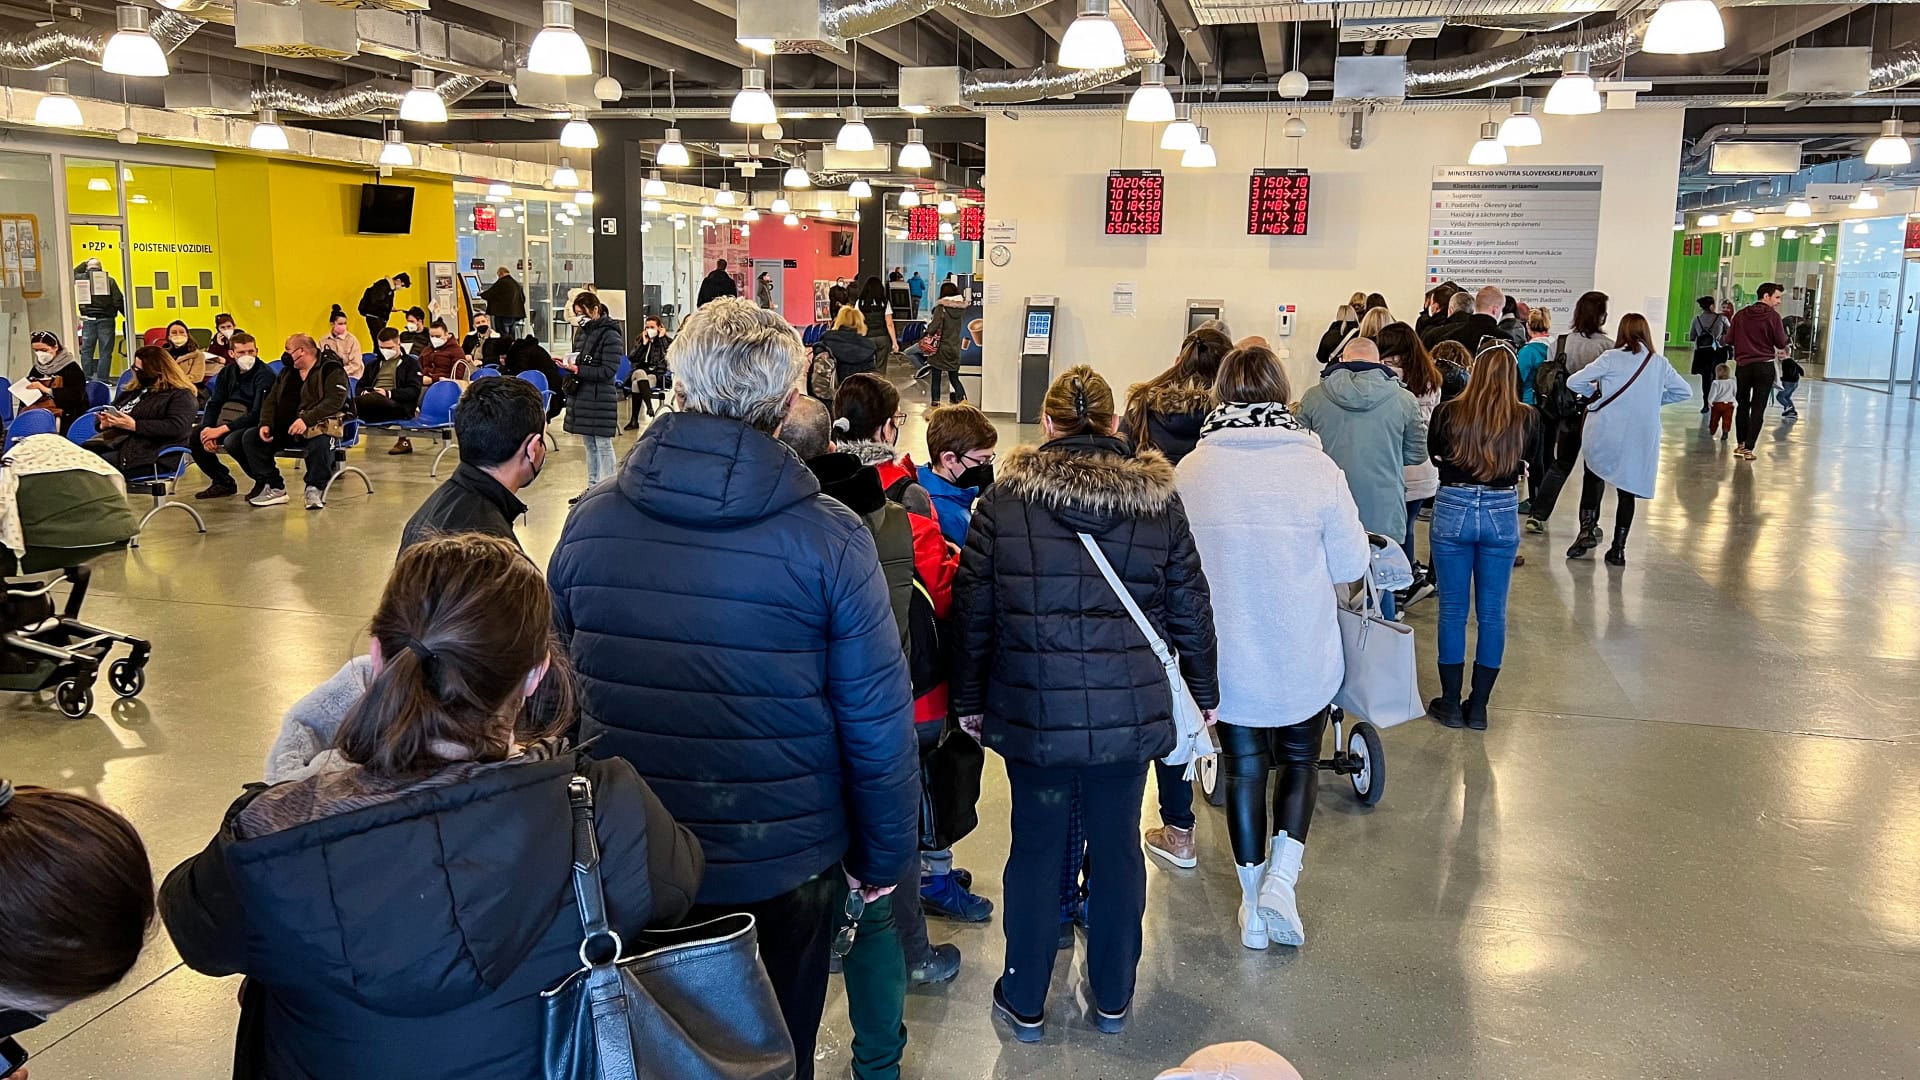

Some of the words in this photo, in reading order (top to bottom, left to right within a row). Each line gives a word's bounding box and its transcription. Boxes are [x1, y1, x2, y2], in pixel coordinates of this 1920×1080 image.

[1110, 178, 1139, 188] 7020
[1146, 178, 1162, 188] 62
[1252, 177, 1284, 187] 3150
[1296, 177, 1308, 187] 18
[1110, 189, 1139, 199] 7019
[1146, 189, 1162, 199] 59
[1252, 188, 1284, 199] 3149
[1290, 188, 1308, 199] 23
[1110, 200, 1138, 210] 7018
[1146, 200, 1161, 210] 58
[1251, 200, 1283, 210] 3148
[1294, 200, 1307, 210] 18
[1110, 212, 1138, 222] 7017
[1145, 212, 1160, 222] 58
[1251, 212, 1282, 222] 3147
[1294, 212, 1306, 222] 18
[1107, 223, 1137, 233] 6505
[1145, 223, 1159, 233] 55
[1250, 223, 1280, 233] 3146
[1293, 223, 1305, 233] 18
[89, 242, 106, 250] PZP
[134, 243, 176, 252] POISTENIE
[177, 244, 213, 253] VOZIDIEL
[1907, 296, 1914, 313] 2
